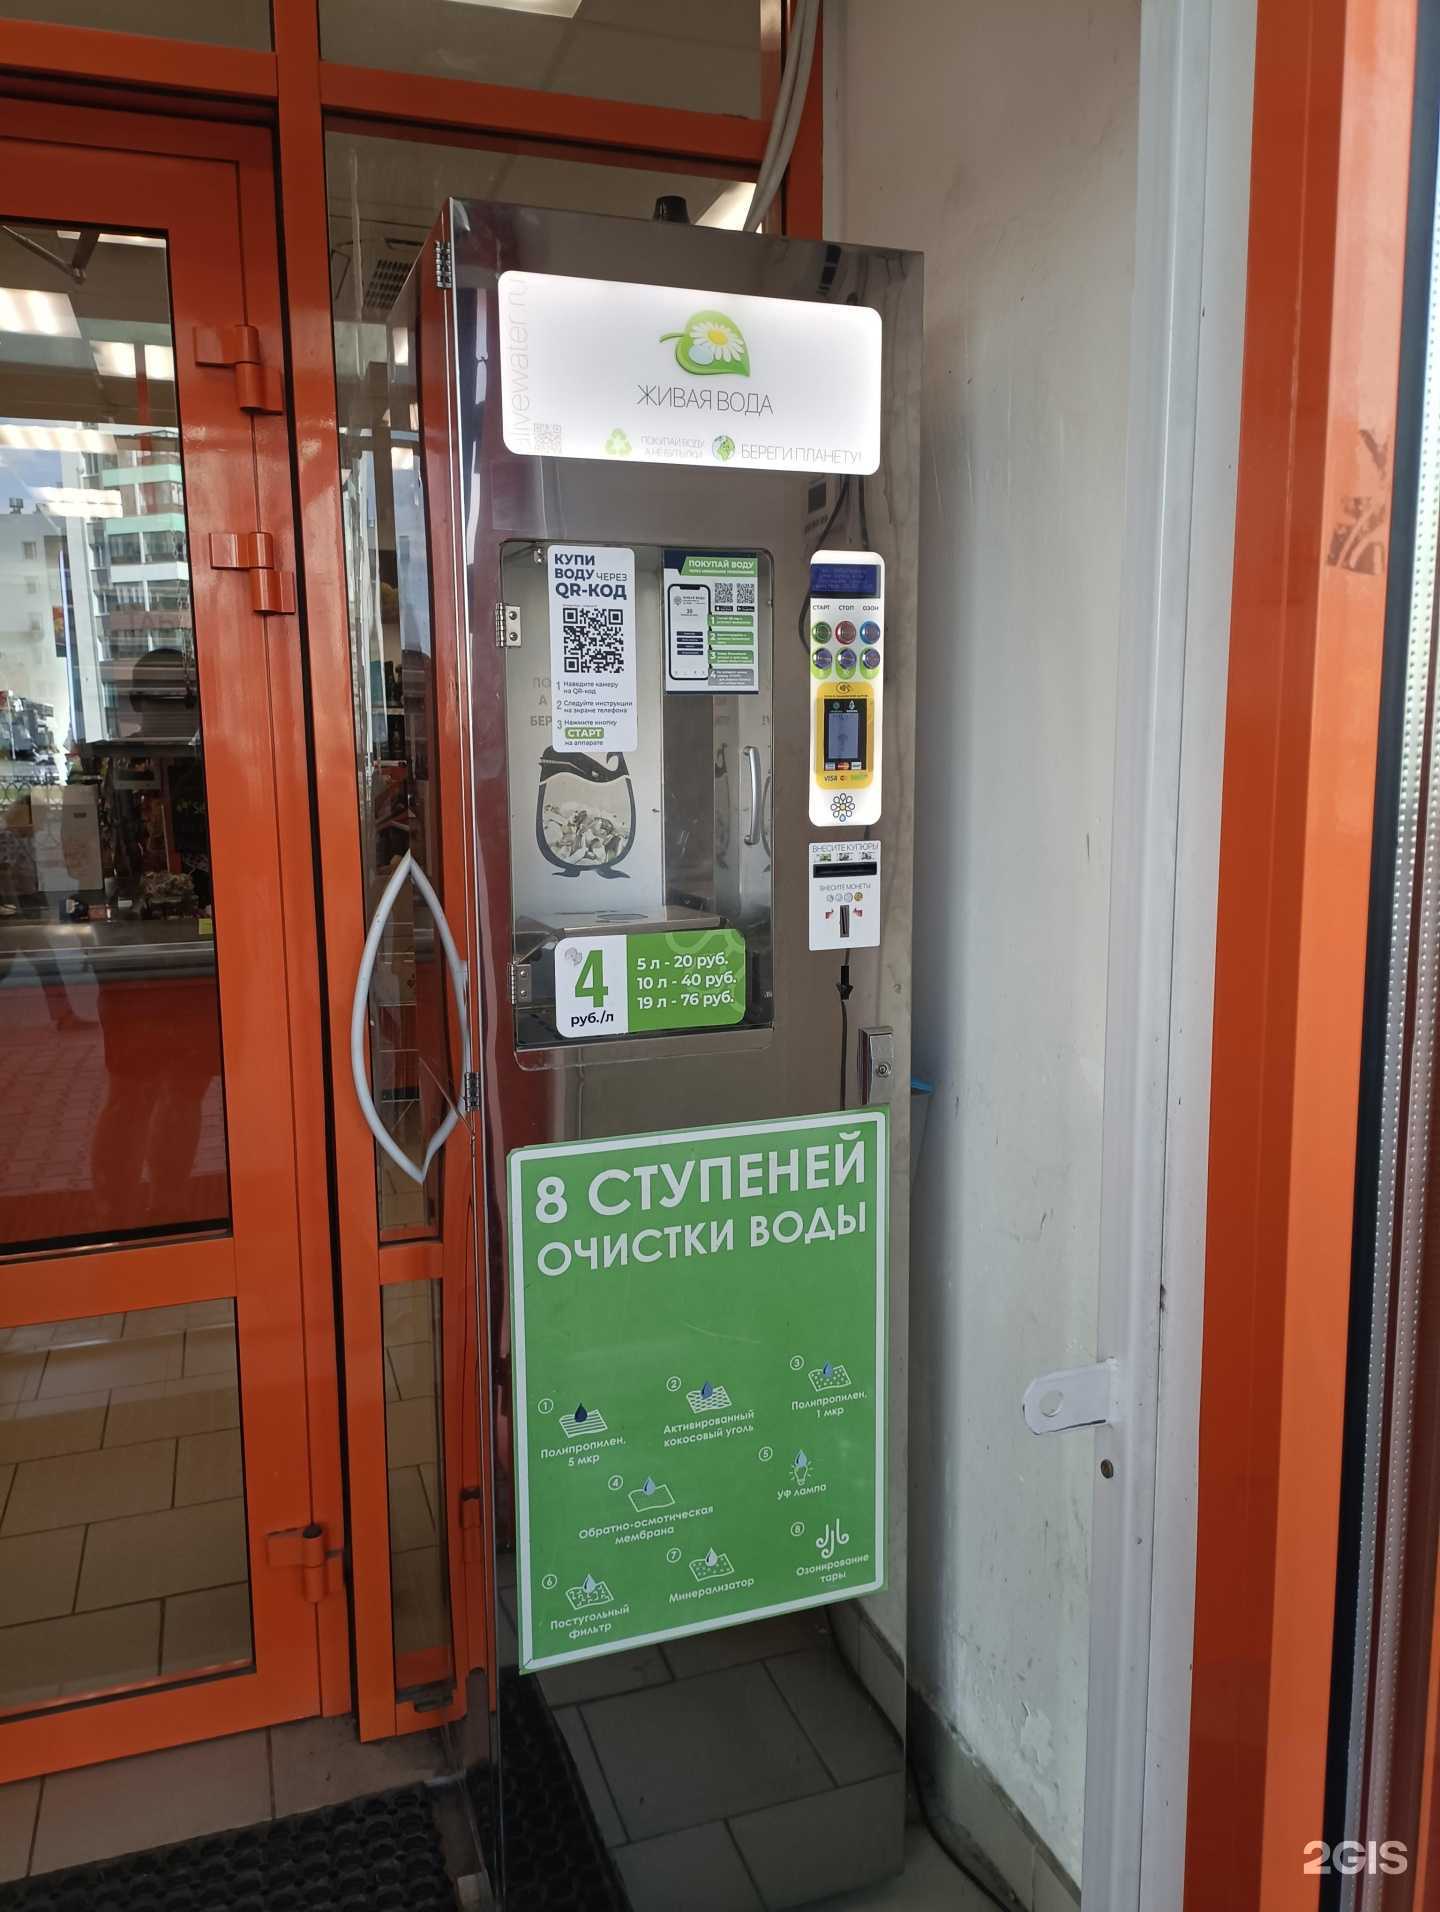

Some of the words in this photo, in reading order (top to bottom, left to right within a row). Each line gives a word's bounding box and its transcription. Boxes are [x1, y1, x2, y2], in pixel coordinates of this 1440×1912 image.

[636, 383, 712, 410] ЖИВАЯ
[716, 389, 773, 415] ВОДА
[741, 443, 793, 460] БЕРЕГИ
[795, 447, 862, 464] ПЛАНЕТУ!
[554, 553, 595, 566] КУПИ
[688, 559, 729, 569] ПОКУПАЙ
[731, 560, 754, 569] ВОДУ
[554, 568, 595, 581] ВОДУ
[596, 572, 628, 581] ЧЕРЕЗ
[555, 582, 627, 600] QR-КОД
[710, 633, 716, 641] 2
[710, 652, 716, 660] 3
[556, 681, 561, 690] 1
[563, 681, 594, 689] Наведите
[556, 701, 562, 710] 2
[556, 720, 562, 730] 3
[812, 844, 846, 853] ВНЕСИТЕ
[636, 959, 647, 970] 5
[650, 960, 660, 970] л
[674, 955, 693, 968] 20
[697, 952, 729, 968] руб.
[574, 949, 609, 1008] 4
[637, 977, 653, 990] 10
[657, 978, 667, 989] л
[681, 974, 701, 987] 40
[705, 971, 737, 987] руб.
[637, 996, 652, 1010] 19
[657, 998, 667, 1009] л
[680, 993, 699, 1006] 76
[703, 991, 735, 1008] руб.
[570, 1010, 614, 1027] руб./л
[535, 1176, 568, 1224] 8
[588, 1130, 865, 1216] СТУПЕНЕЙ
[537, 1218, 735, 1277] ОЧИСТКИ
[750, 1201, 866, 1248] ВОДЫ
[791, 1391, 868, 1412] Полипропилен.
[823, 1407, 844, 1417] мкр
[663, 1410, 755, 1434] Активированный
[663, 1429, 723, 1448] кокосовый
[725, 1424, 754, 1438] уголь
[540, 1436, 626, 1459] Полипропилен.
[568, 1457, 575, 1467] 5
[578, 1454, 600, 1465] мкр
[794, 1482, 827, 1497] лампа
[578, 1505, 714, 1540] Обратно-осмотическая
[614, 1526, 675, 1545] мембрана
[796, 1553, 869, 1576] Озонирование
[820, 1572, 846, 1585] тары
[668, 1577, 755, 1604] Минерализатор
[550, 1604, 630, 1630] Постугольный
[569, 1623, 612, 1640] фильтр
